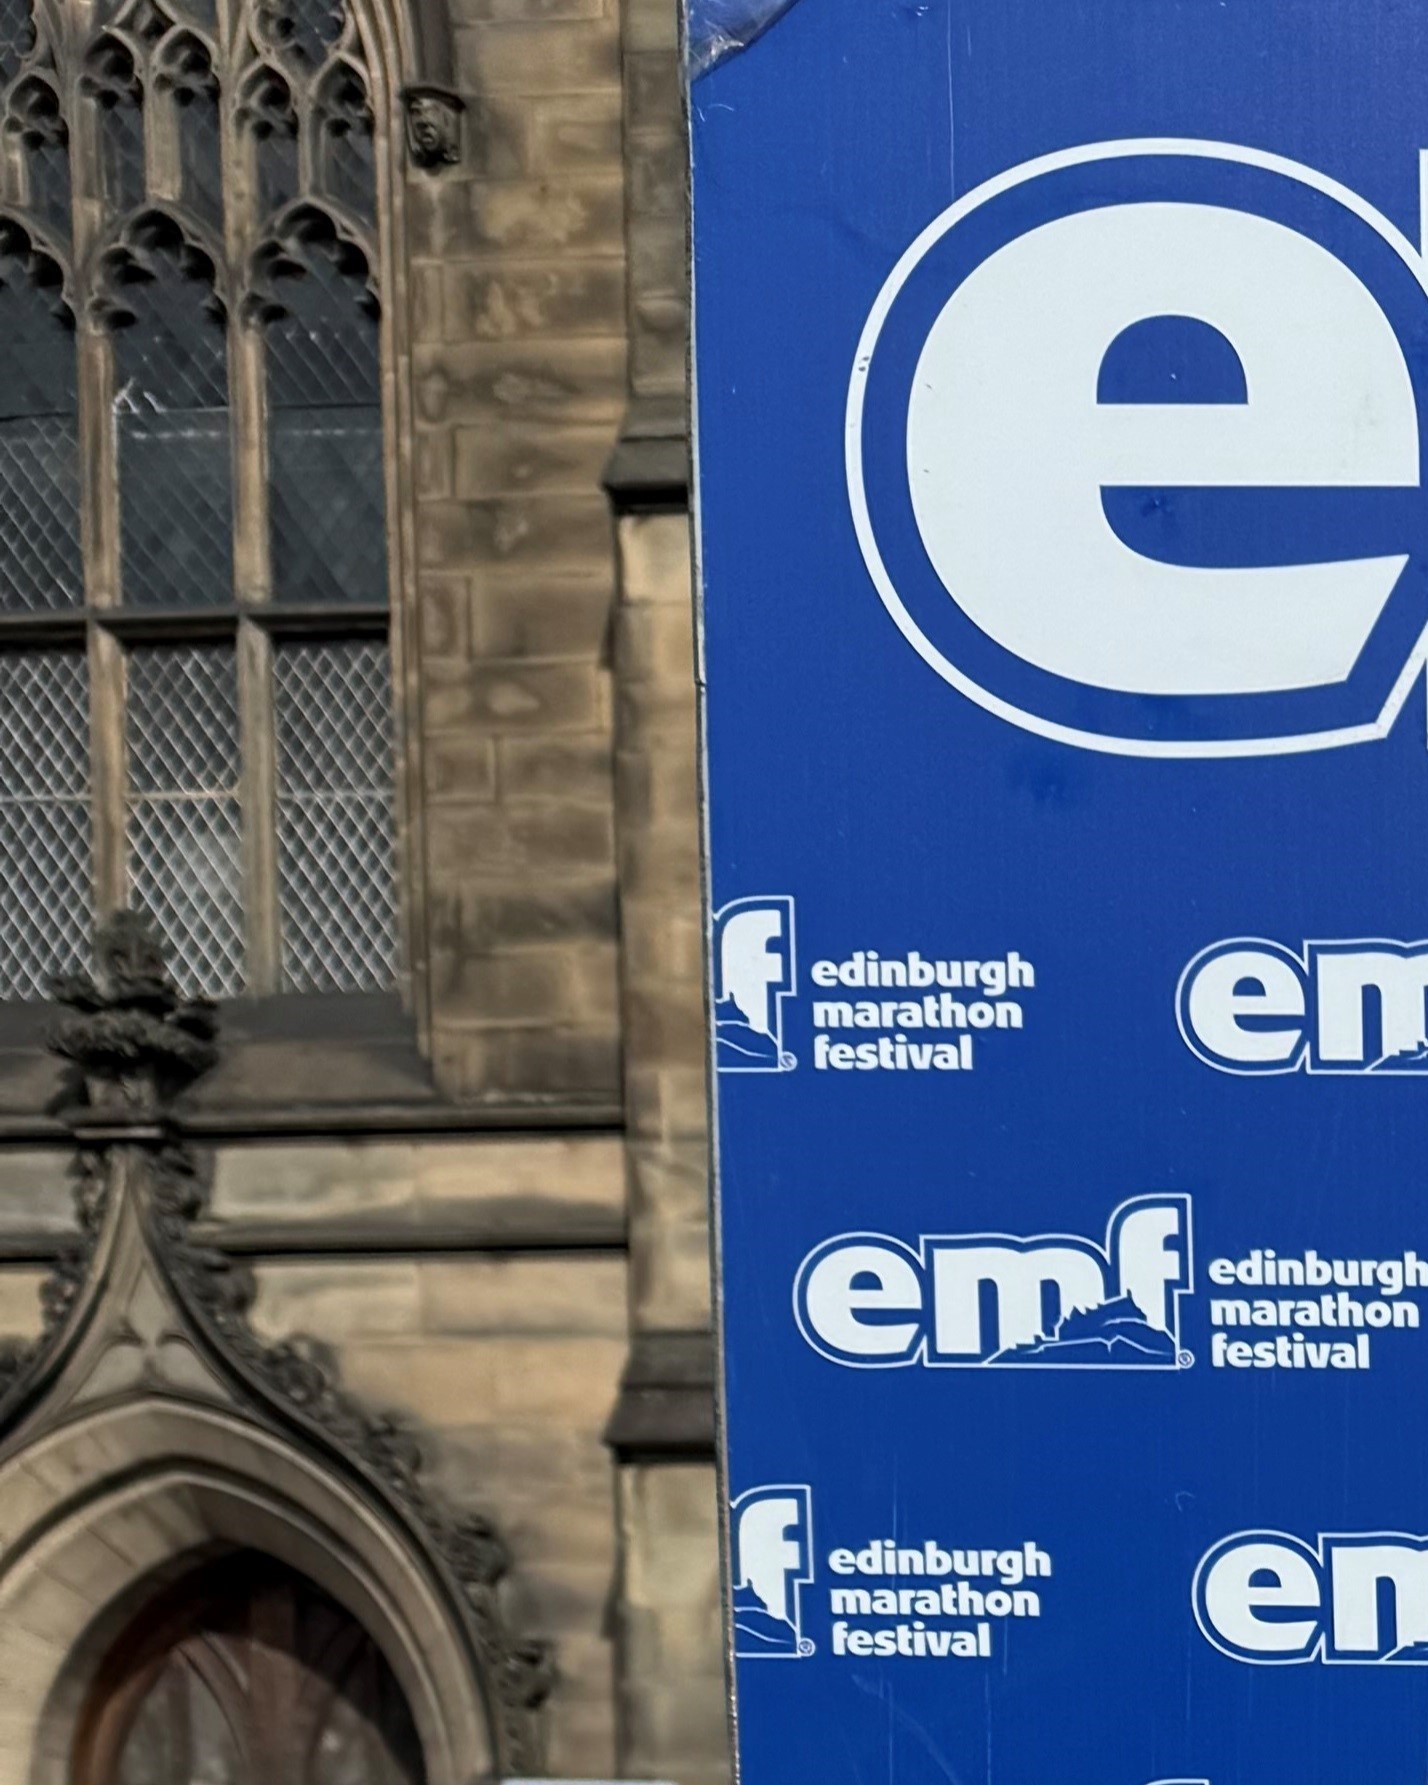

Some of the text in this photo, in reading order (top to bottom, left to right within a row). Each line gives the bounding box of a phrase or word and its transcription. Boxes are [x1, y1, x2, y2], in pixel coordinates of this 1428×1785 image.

[811, 951, 1035, 997] edinburgh
[812, 992, 1023, 1029] marathon
[813, 1034, 973, 1070] festival
[800, 1200, 1188, 1363] emf
[1210, 1291, 1420, 1328] marathon
[1211, 1332, 1370, 1369] festival
[828, 1539, 1052, 1586] edinburgh
[830, 1580, 1041, 1617] marathon
[832, 1620, 991, 1657] festival
